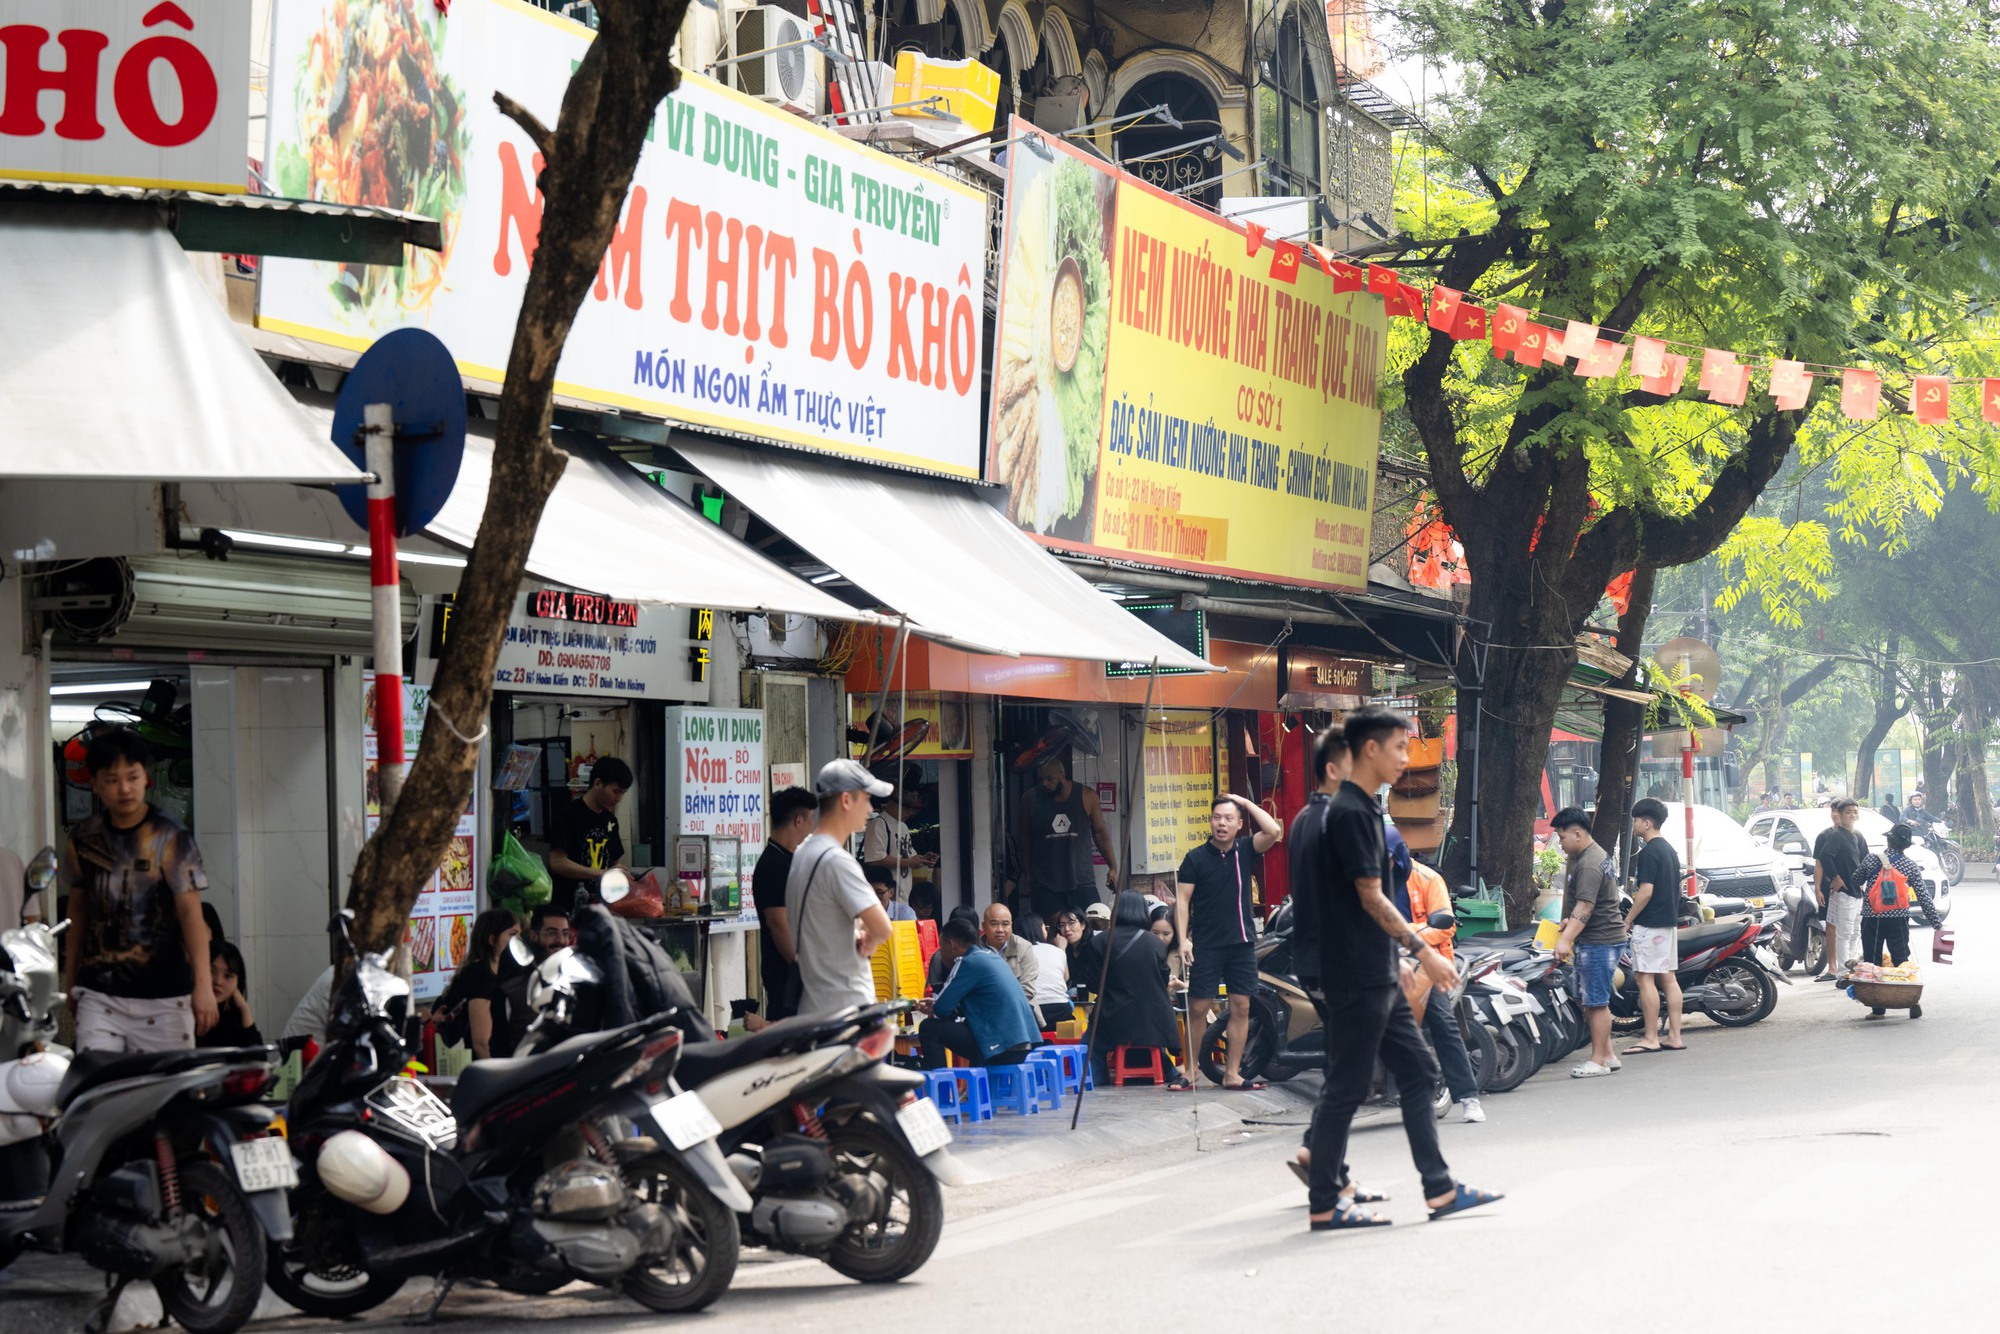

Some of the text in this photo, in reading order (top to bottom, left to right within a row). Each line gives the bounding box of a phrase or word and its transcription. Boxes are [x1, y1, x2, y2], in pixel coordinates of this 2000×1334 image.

[666, 95, 695, 157] VI
[703, 112, 779, 189] DUNG
[804, 153, 844, 214] GIA
[851, 182, 941, 247] TRUYỀN
[493, 141, 976, 397] NM THỊT BÒ KHÔ
[1119, 226, 1379, 410] NEM NƯỚNG NHA TRANG QUẾ HOA
[634, 348, 886, 442] MÓN NGON ẨM THỰC VIỆT
[1237, 381, 1282, 431] CƠ SỞ 1
[1109, 391, 1135, 466] ĐẶC
[1137, 392, 1162, 461] SẢN
[1162, 414, 1189, 470] NEM
[1189, 416, 1227, 478] NƯỚNG
[1227, 432, 1248, 484] NHA
[1250, 438, 1281, 491] TRANG
[1287, 441, 1314, 499] CHÍNH
[1313, 442, 1331, 503] GỐC
[1131, 477, 1140, 502] 23
[1127, 511, 1140, 550] 31
[536, 591, 567, 619] GIA
[519, 627, 539, 648] ĐẶT
[513, 667, 525, 684] 23
[588, 672, 599, 688] 51
[1316, 666, 1332, 685] SALE
[1346, 670, 1358, 686] OFF
[684, 716, 761, 743] LONG VI DUNG
[685, 746, 727, 791] Nộm
[735, 746, 750, 764] BÒ
[735, 770, 761, 784] CHIM
[685, 790, 761, 819] BÁNH BỘT LỌC
[751, 818, 761, 844] XÙ
